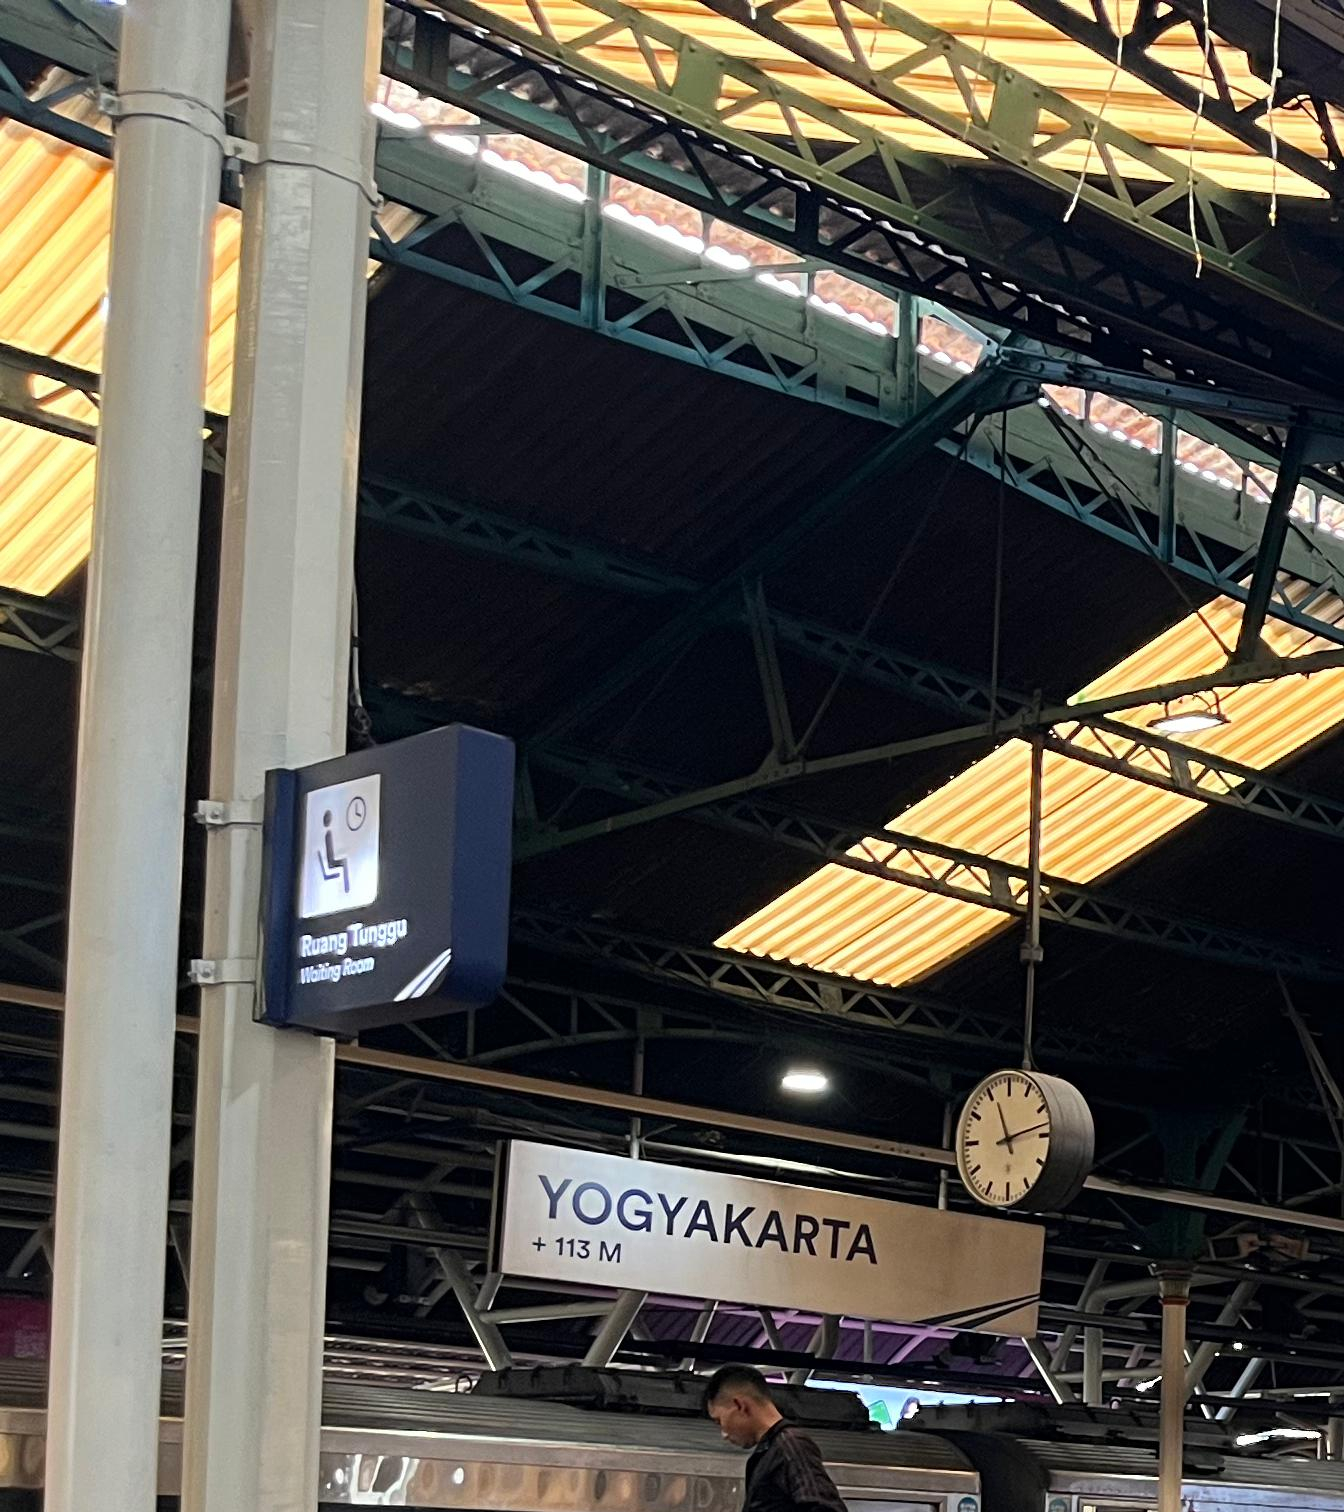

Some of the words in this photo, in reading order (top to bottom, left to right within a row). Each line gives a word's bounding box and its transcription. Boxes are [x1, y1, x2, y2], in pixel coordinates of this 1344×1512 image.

[300, 932, 347, 957] Ruang
[348, 918, 408, 947] Tunggu
[301, 962, 341, 984] Waiting
[342, 957, 375, 976] Room
[538, 1174, 878, 1265] YOGYAKARTA
[556, 1237, 590, 1260] 113
[600, 1241, 621, 1263] M
